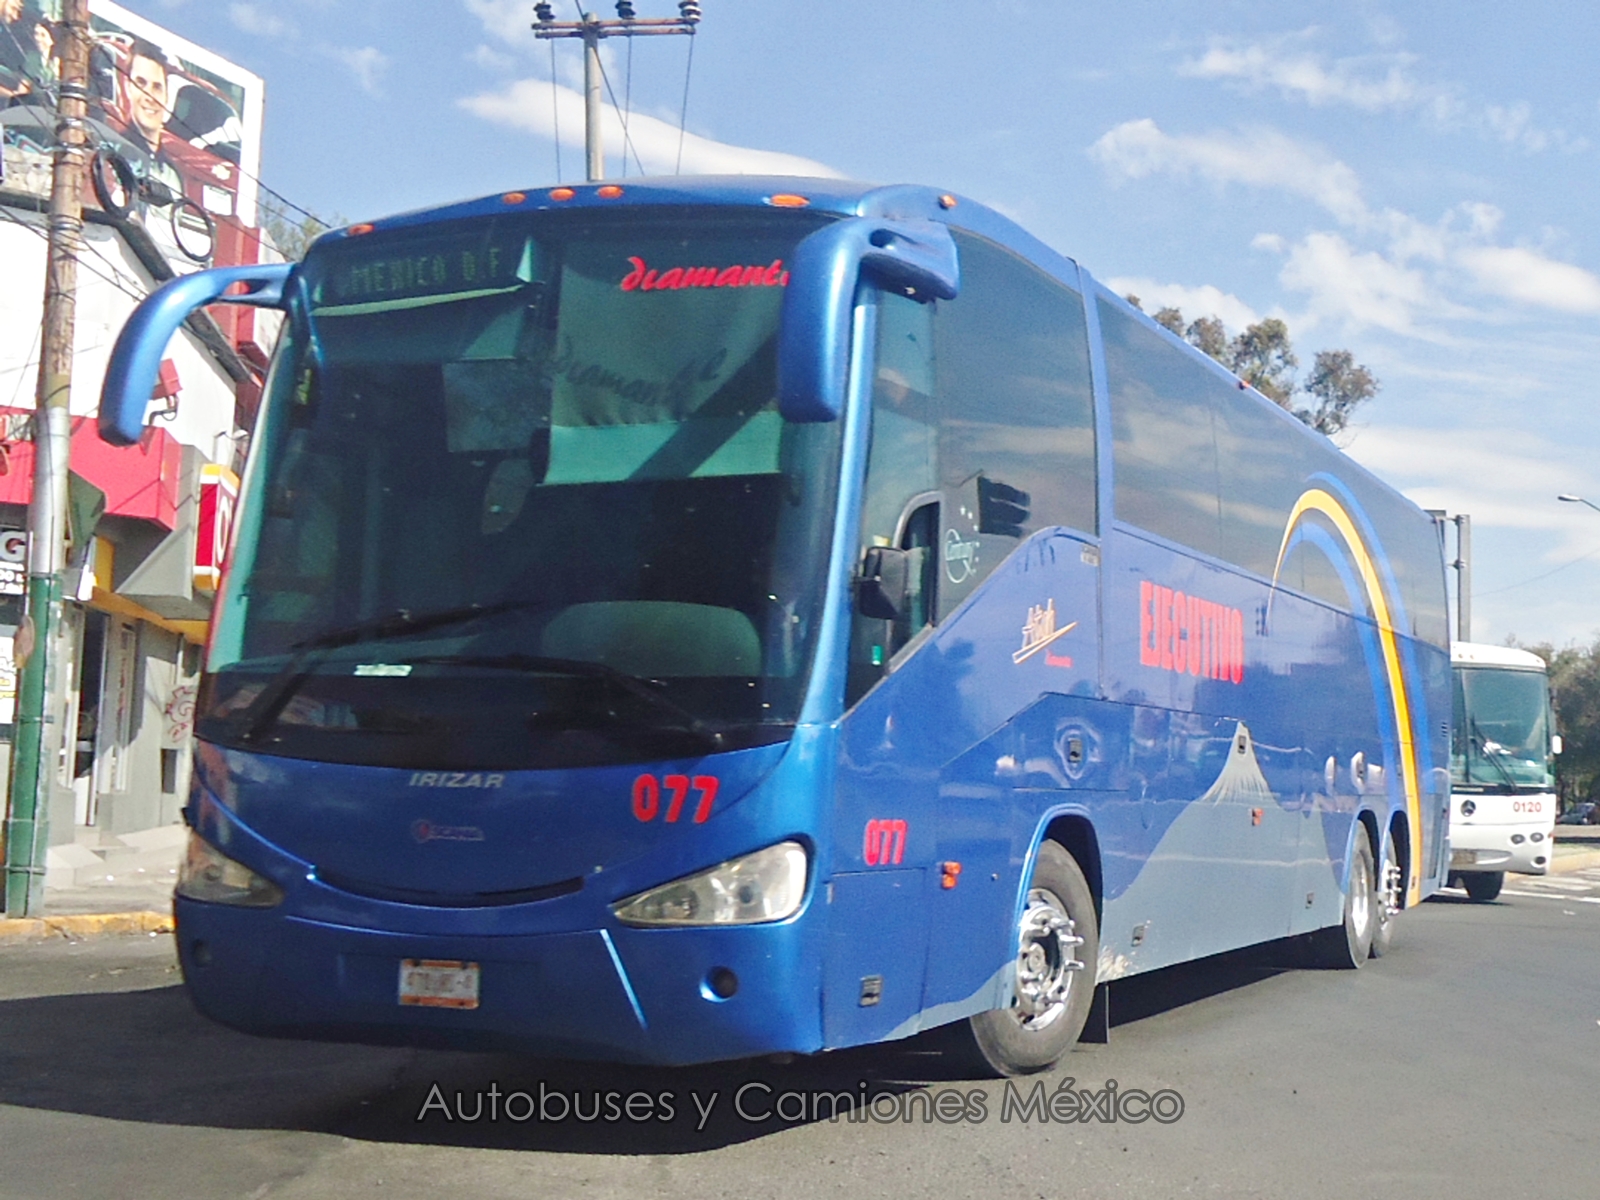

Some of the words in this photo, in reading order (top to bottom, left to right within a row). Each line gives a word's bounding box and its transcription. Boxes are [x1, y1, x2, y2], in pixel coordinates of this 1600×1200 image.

[1140, 579, 1244, 685] EJECUTIVO
[409, 772, 505, 788] IRIZAR
[632, 773, 719, 823] 077
[1513, 801, 1542, 813] 0120
[864, 819, 907, 865] 077
